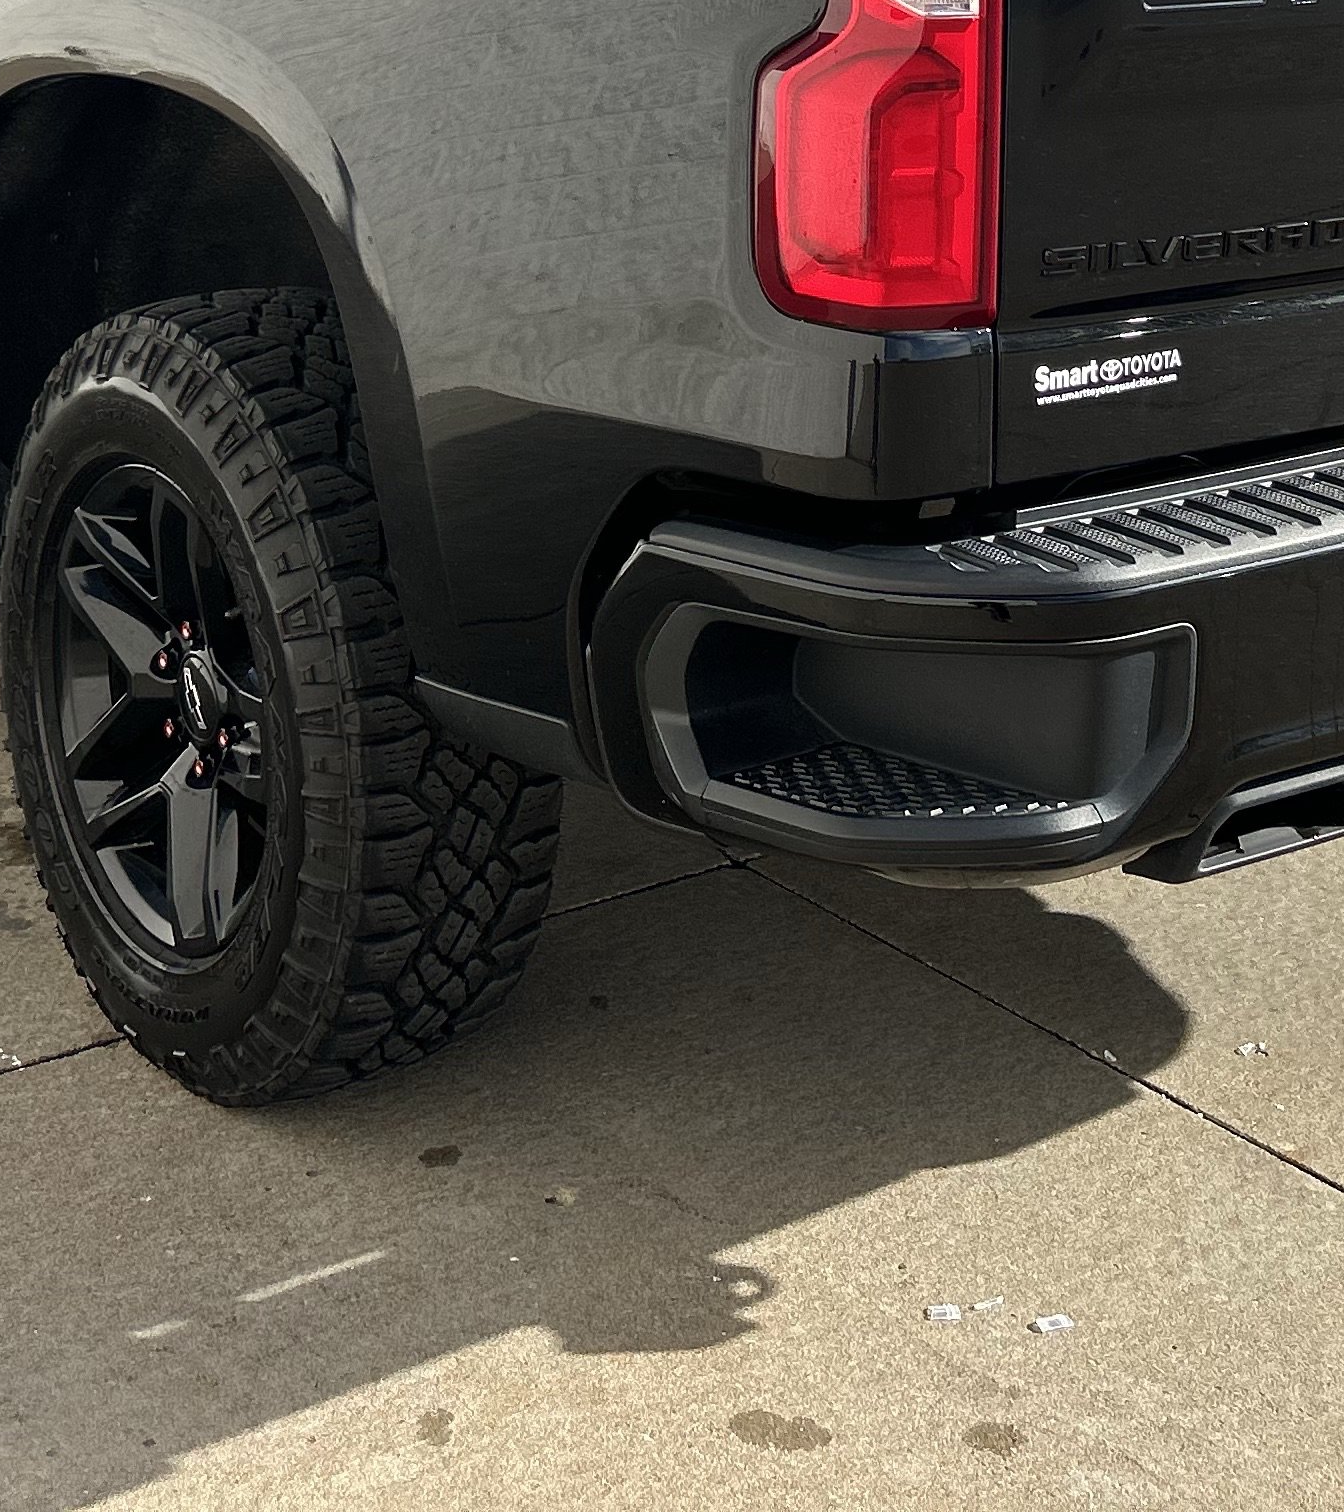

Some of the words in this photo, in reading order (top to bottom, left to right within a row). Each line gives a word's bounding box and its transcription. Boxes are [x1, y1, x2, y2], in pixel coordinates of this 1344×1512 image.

[1035, 359, 1099, 392] Smart
[1122, 348, 1182, 377] TOYOTA
[1036, 373, 1178, 406] www.smarttoyotaquadcities.com
